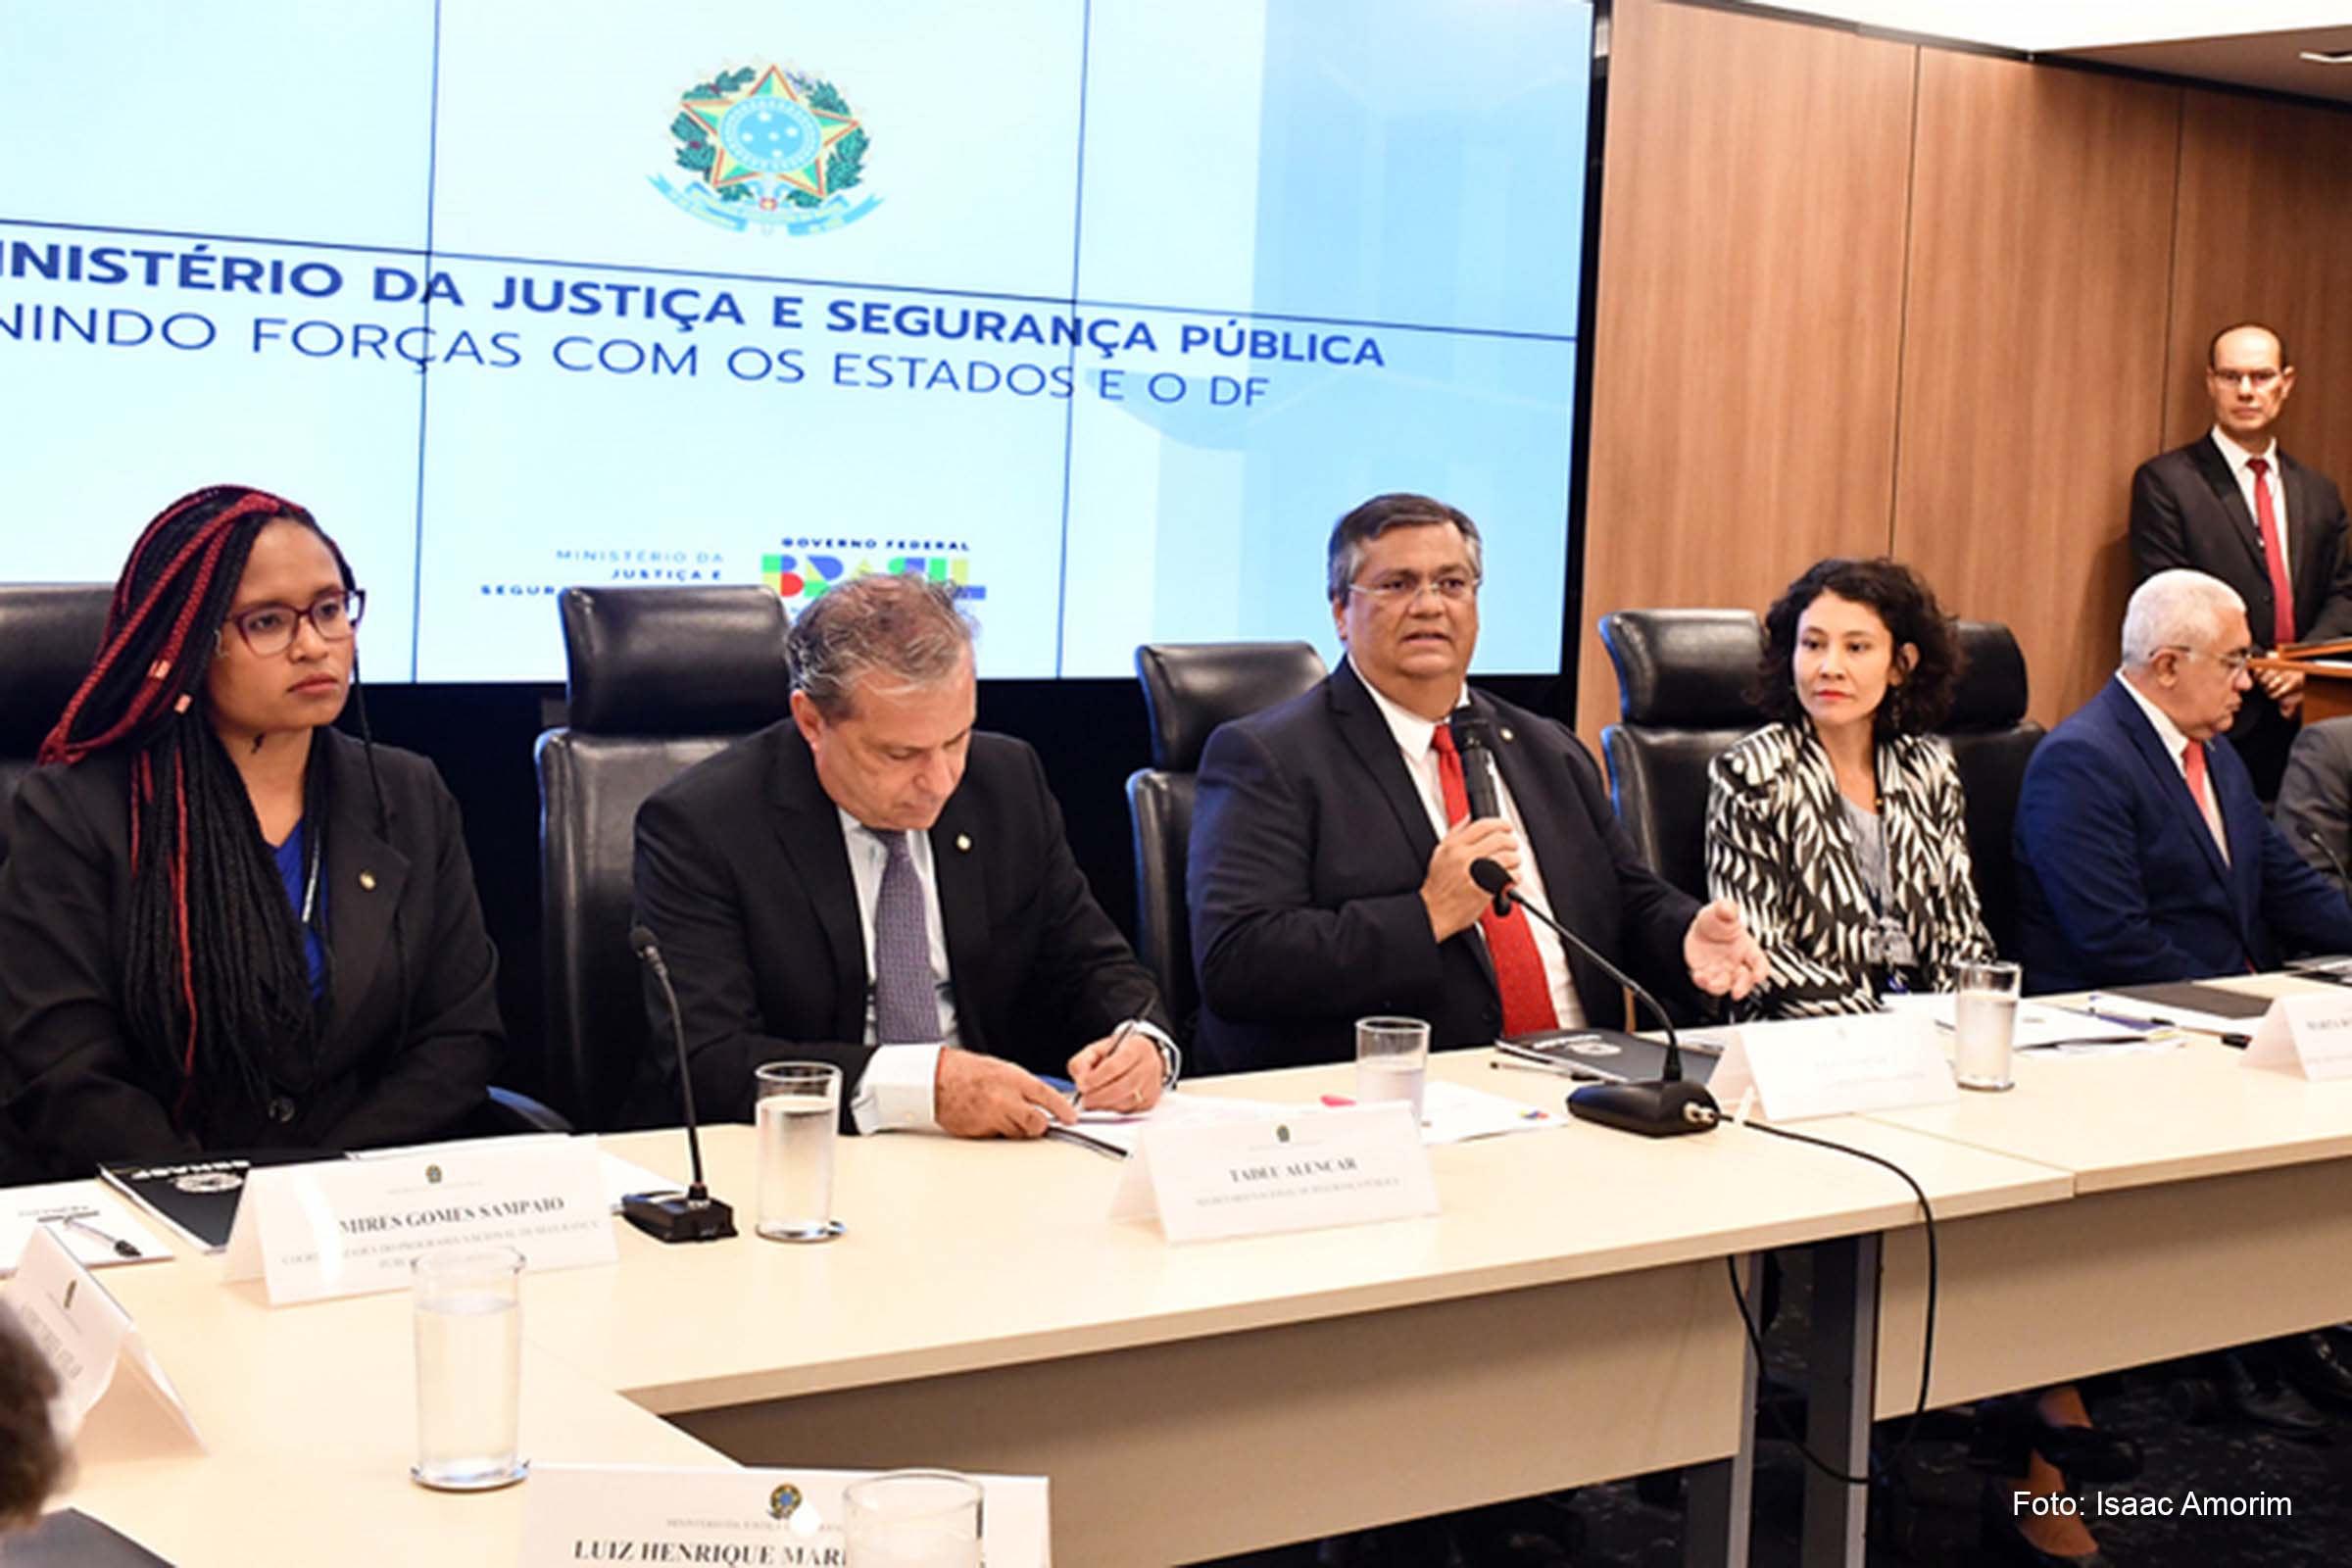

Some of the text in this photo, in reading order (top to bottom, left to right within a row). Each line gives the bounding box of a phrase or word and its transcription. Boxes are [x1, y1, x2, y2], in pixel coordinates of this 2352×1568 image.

[0, 241, 1386, 368] NISTÉRIO DA JUSTIÇA E SEGURANÇA PÚBLICA
[253, 317, 521, 374] FORÇAS
[553, 335, 698, 377] COM
[727, 346, 806, 384] OS
[833, 352, 1073, 399] ESTADOS
[1099, 368, 1126, 401] E
[1148, 372, 1188, 405] O
[1209, 375, 1271, 408] DF
[781, 537, 969, 552] GOVERNO FEDERAL
[696, 552, 723, 564] DA
[612, 569, 722, 582] JUSTIÇA E
[481, 585, 558, 596] SEGUR
[573, 1539, 635, 1562] LUIZ
[640, 1541, 775, 1568] HENRIQUE
